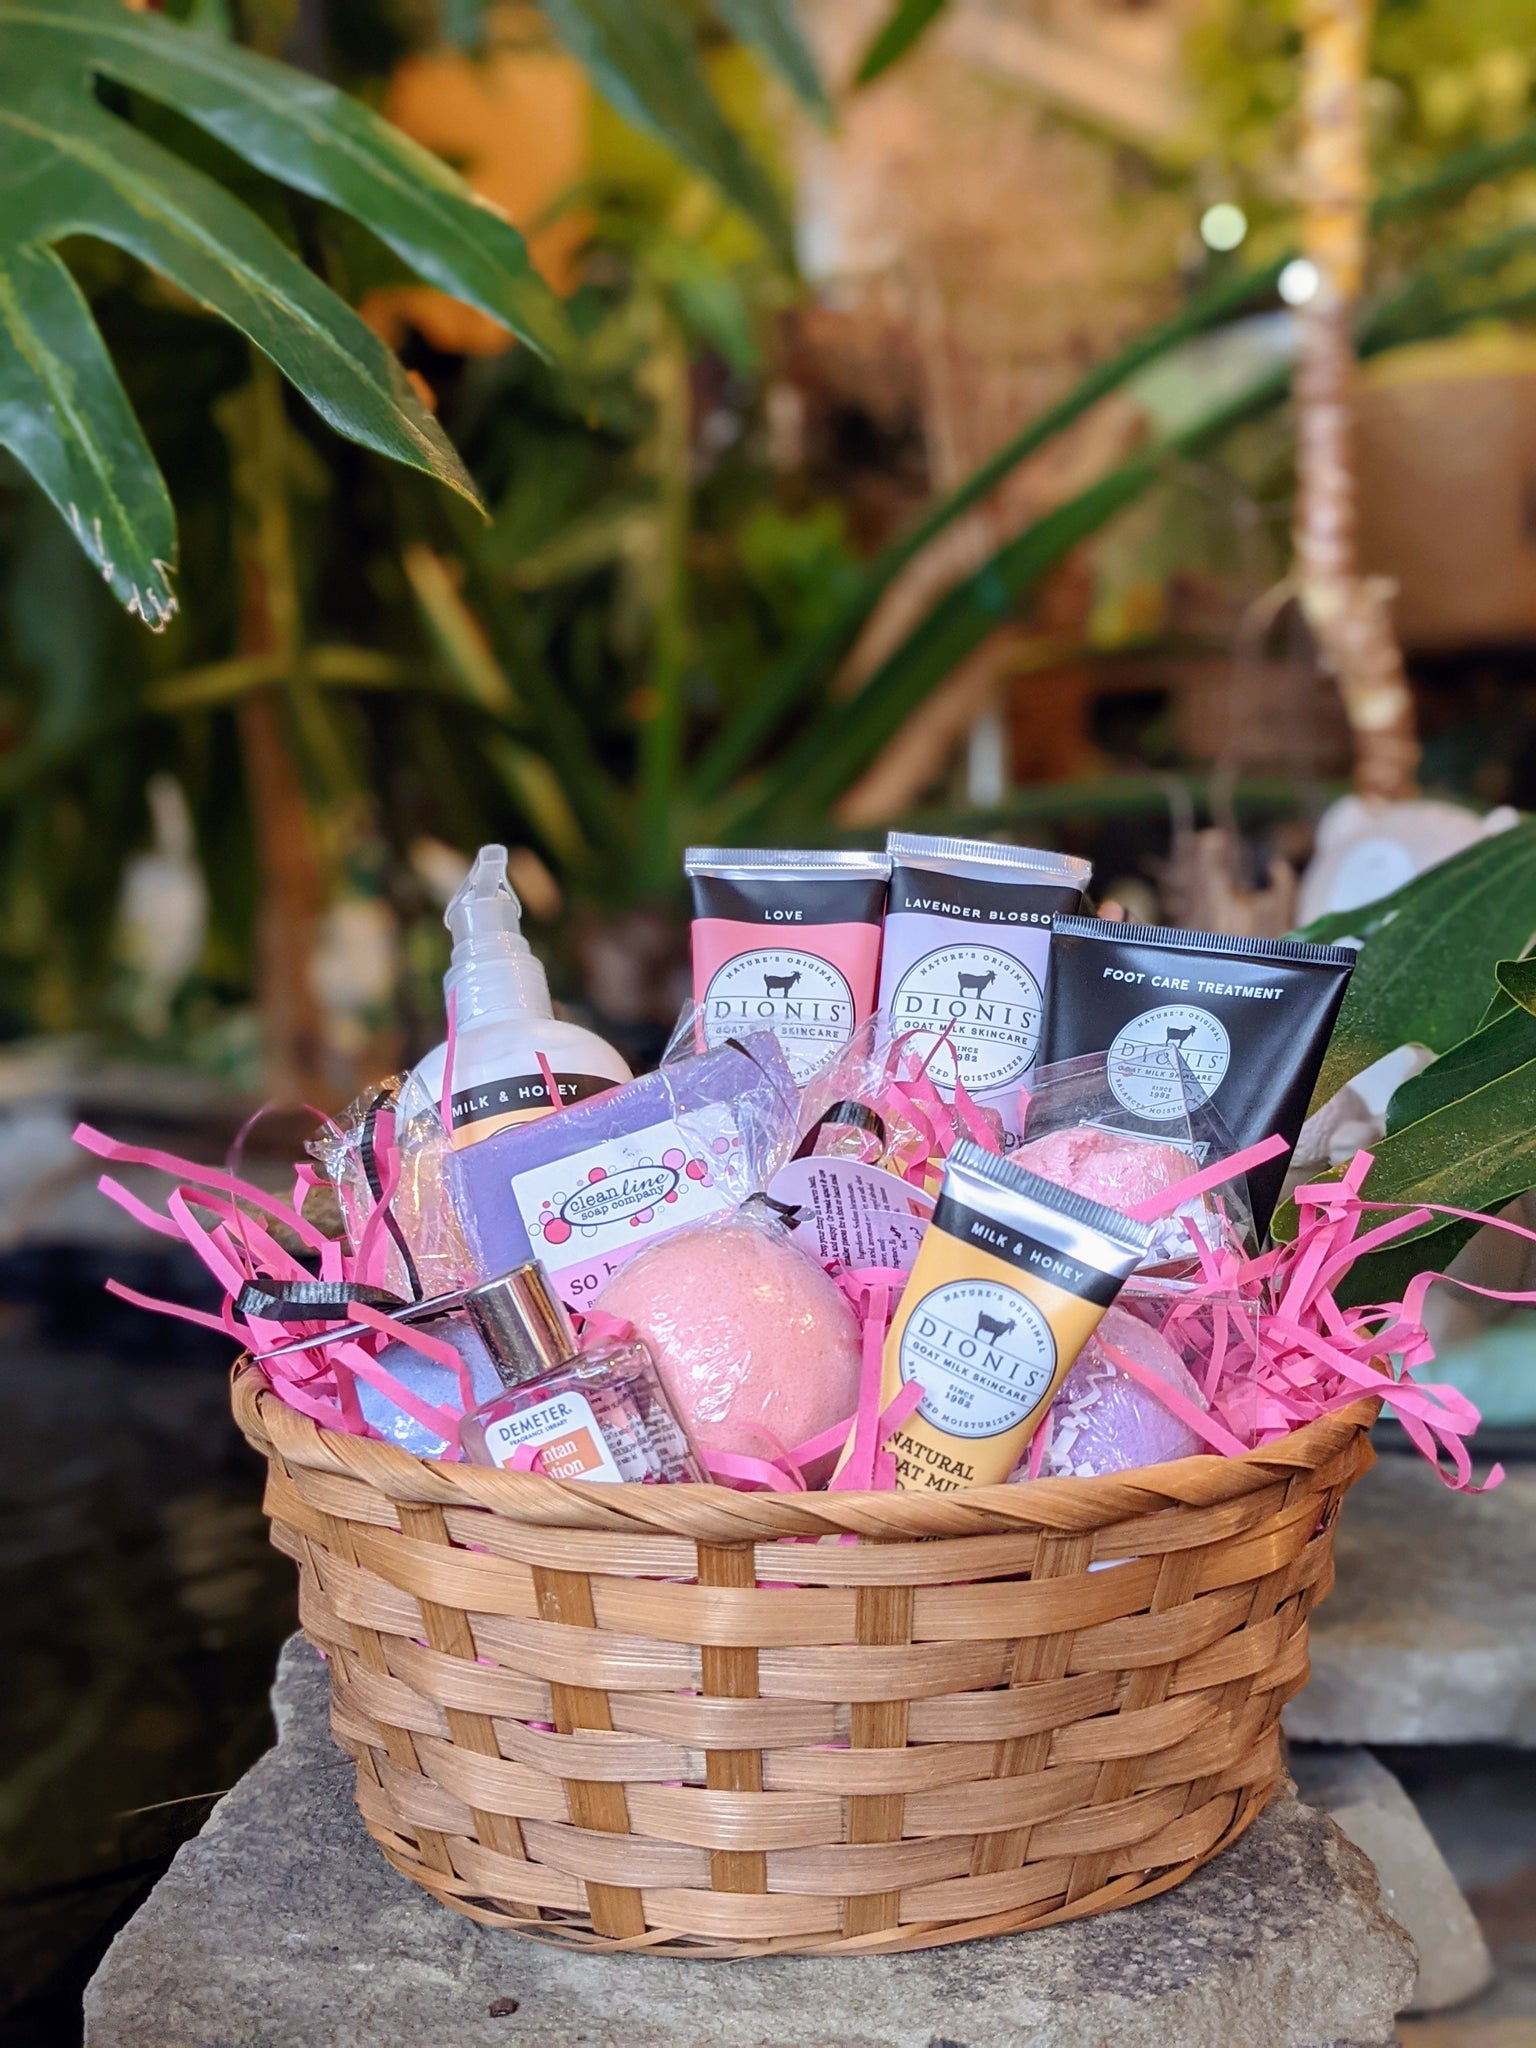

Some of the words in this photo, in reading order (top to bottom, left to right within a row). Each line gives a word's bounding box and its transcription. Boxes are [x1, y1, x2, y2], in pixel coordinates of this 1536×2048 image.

[764, 910, 803, 921] LOVE
[904, 897, 981, 919] LAVENDER
[989, 910, 1056, 925] BLOSSO
[725, 956, 780, 980] NATURE'S
[786, 956, 837, 988] ORIGINAL
[919, 951, 976, 976] NATURE'S
[982, 954, 1031, 995] ORIGINAL
[1102, 967, 1146, 984] FOOT
[1151, 975, 1190, 991] CARE
[1196, 980, 1284, 1000] TREATMENT
[714, 1000, 841, 1023] DIONIS
[904, 995, 1033, 1030] DIONIS
[781, 1026, 840, 1039] SKINCARE
[903, 1020, 935, 1030] GOAT
[939, 1023, 966, 1035] MLK
[970, 1027, 1029, 1046] SKINCARE
[1137, 1010, 1184, 1029] NATURE'S
[1187, 1011, 1222, 1042] ORIGINAL
[956, 1045, 980, 1054] INCE
[956, 1053, 978, 1063] 982
[1144, 1069, 1166, 1078] MILK
[1168, 1072, 1213, 1082] SKNCARE
[452, 1095, 490, 1118] MILK
[499, 1091, 509, 1103] &
[519, 1084, 578, 1099] HOEY
[1149, 1092, 1171, 1100] 1982
[580, 1205, 609, 1221] soap
[611, 1184, 665, 1210] company
[970, 1221, 1008, 1248] MILK
[1012, 1242, 1024, 1257] &
[1029, 1249, 1084, 1284] HONEY
[569, 1273, 599, 1296] so
[943, 1288, 1004, 1303] NATURE'S
[1009, 1300, 1046, 1353] ORIGINAL
[917, 1317, 1043, 1388] DIONIS
[912, 1341, 941, 1362] GOAT
[943, 1357, 969, 1376] MILK
[972, 1372, 1028, 1403] SKINCARE
[944, 1391, 972, 1409] 1982
[948, 1383, 975, 1401] SINCE
[499, 1403, 569, 1442] DEMETER
[509, 1428, 544, 1446] FRAGRANCE
[544, 1418, 568, 1433] LIBRARY
[541, 1440, 579, 1465] ntan
[888, 1431, 975, 1481] NATURAL
[548, 1458, 586, 1480] tion
